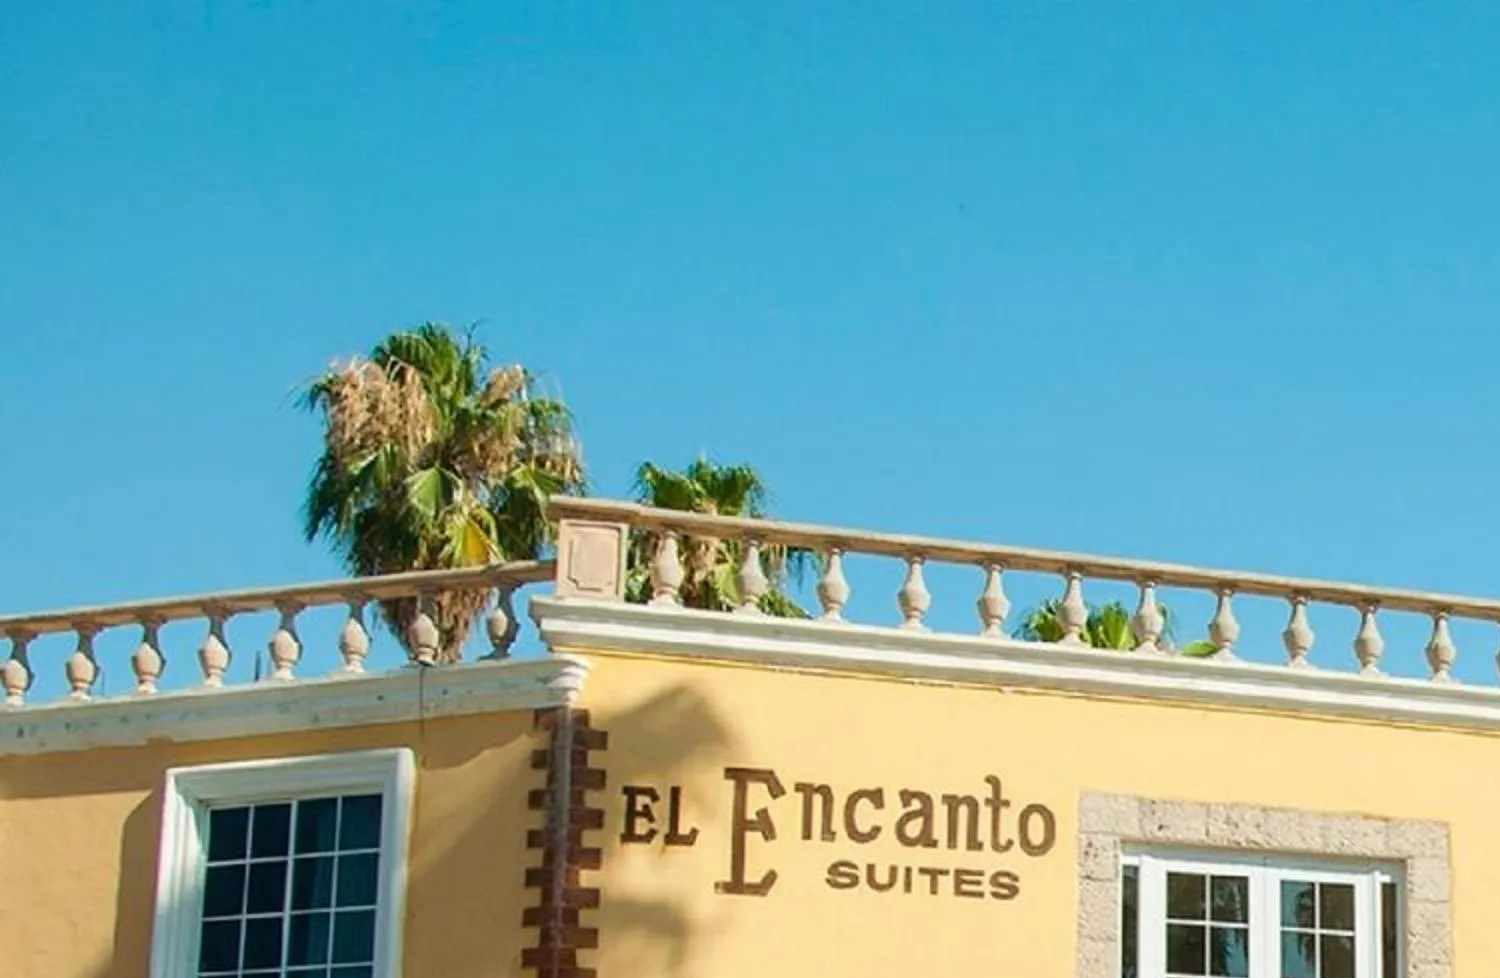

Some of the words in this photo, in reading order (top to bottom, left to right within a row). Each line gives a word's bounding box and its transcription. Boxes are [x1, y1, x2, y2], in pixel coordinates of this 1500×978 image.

[620, 785, 699, 846] EL
[713, 766, 1056, 897] Encanto
[825, 860, 1020, 900] SUITES
